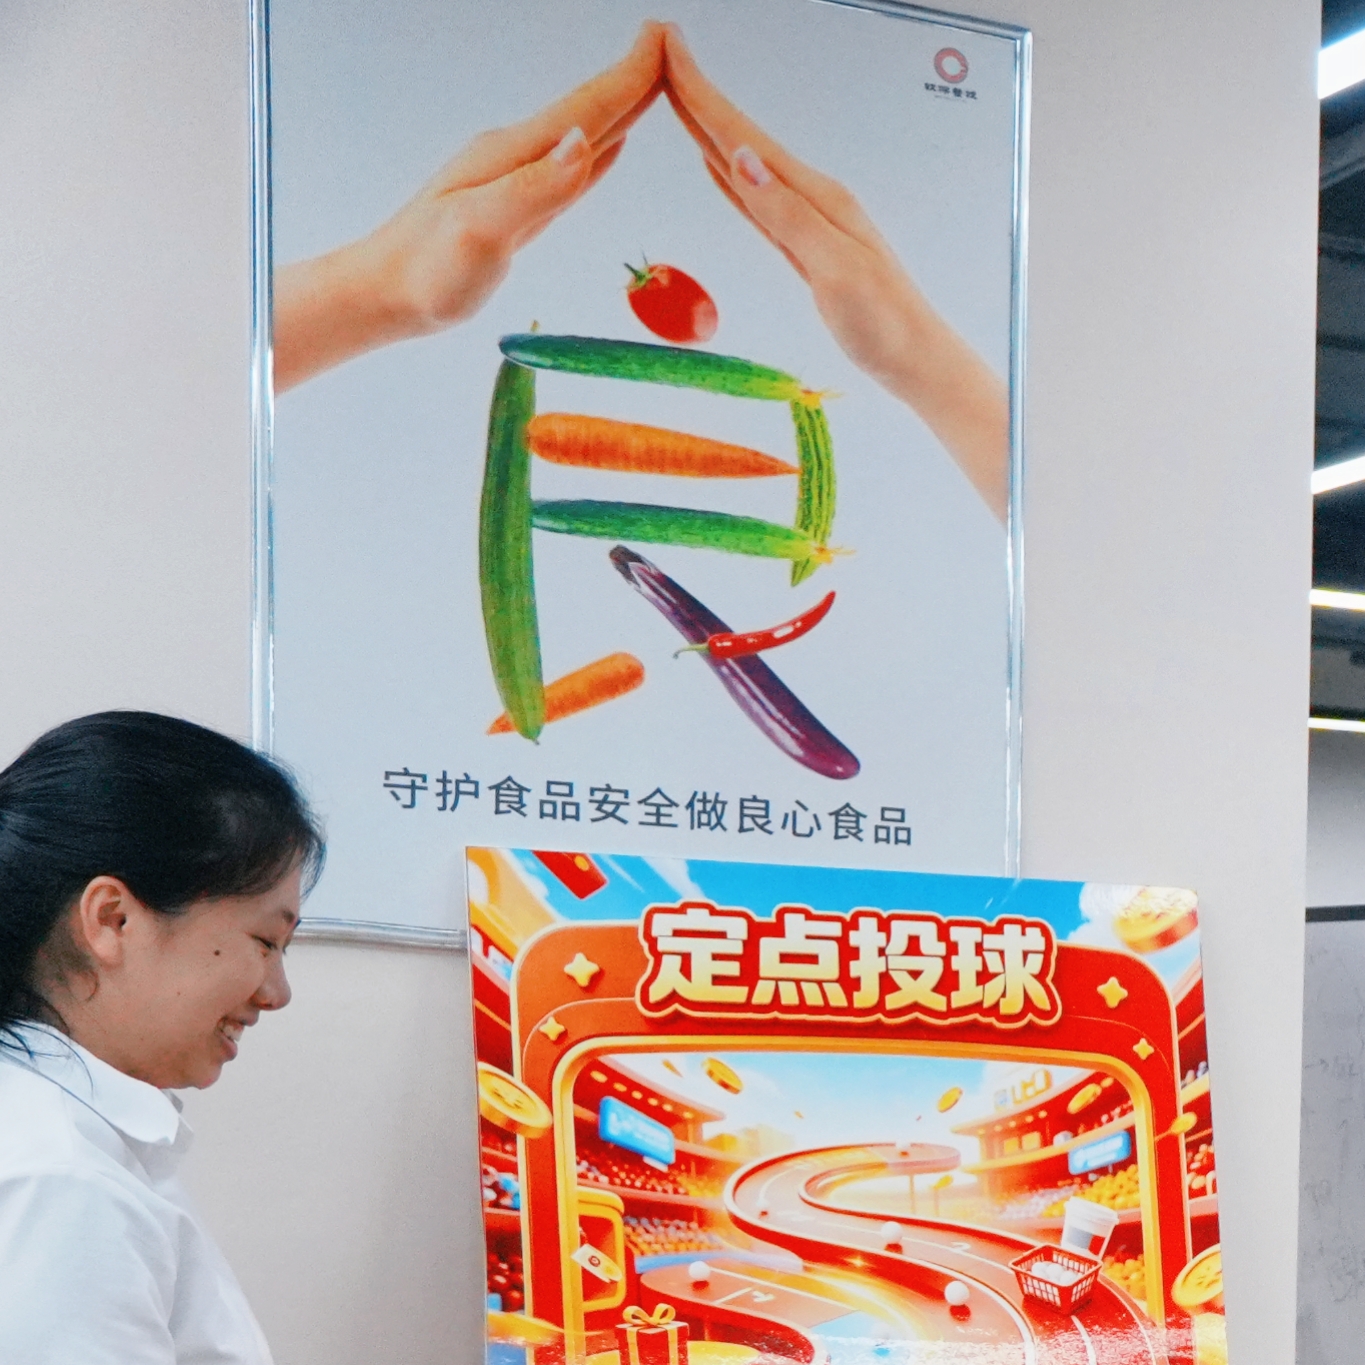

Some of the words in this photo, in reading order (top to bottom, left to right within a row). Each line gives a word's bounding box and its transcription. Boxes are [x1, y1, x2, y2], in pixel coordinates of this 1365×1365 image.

[382, 767, 913, 846] 守护食品安全做良心食品
[648, 907, 1052, 1015] 定点投球
